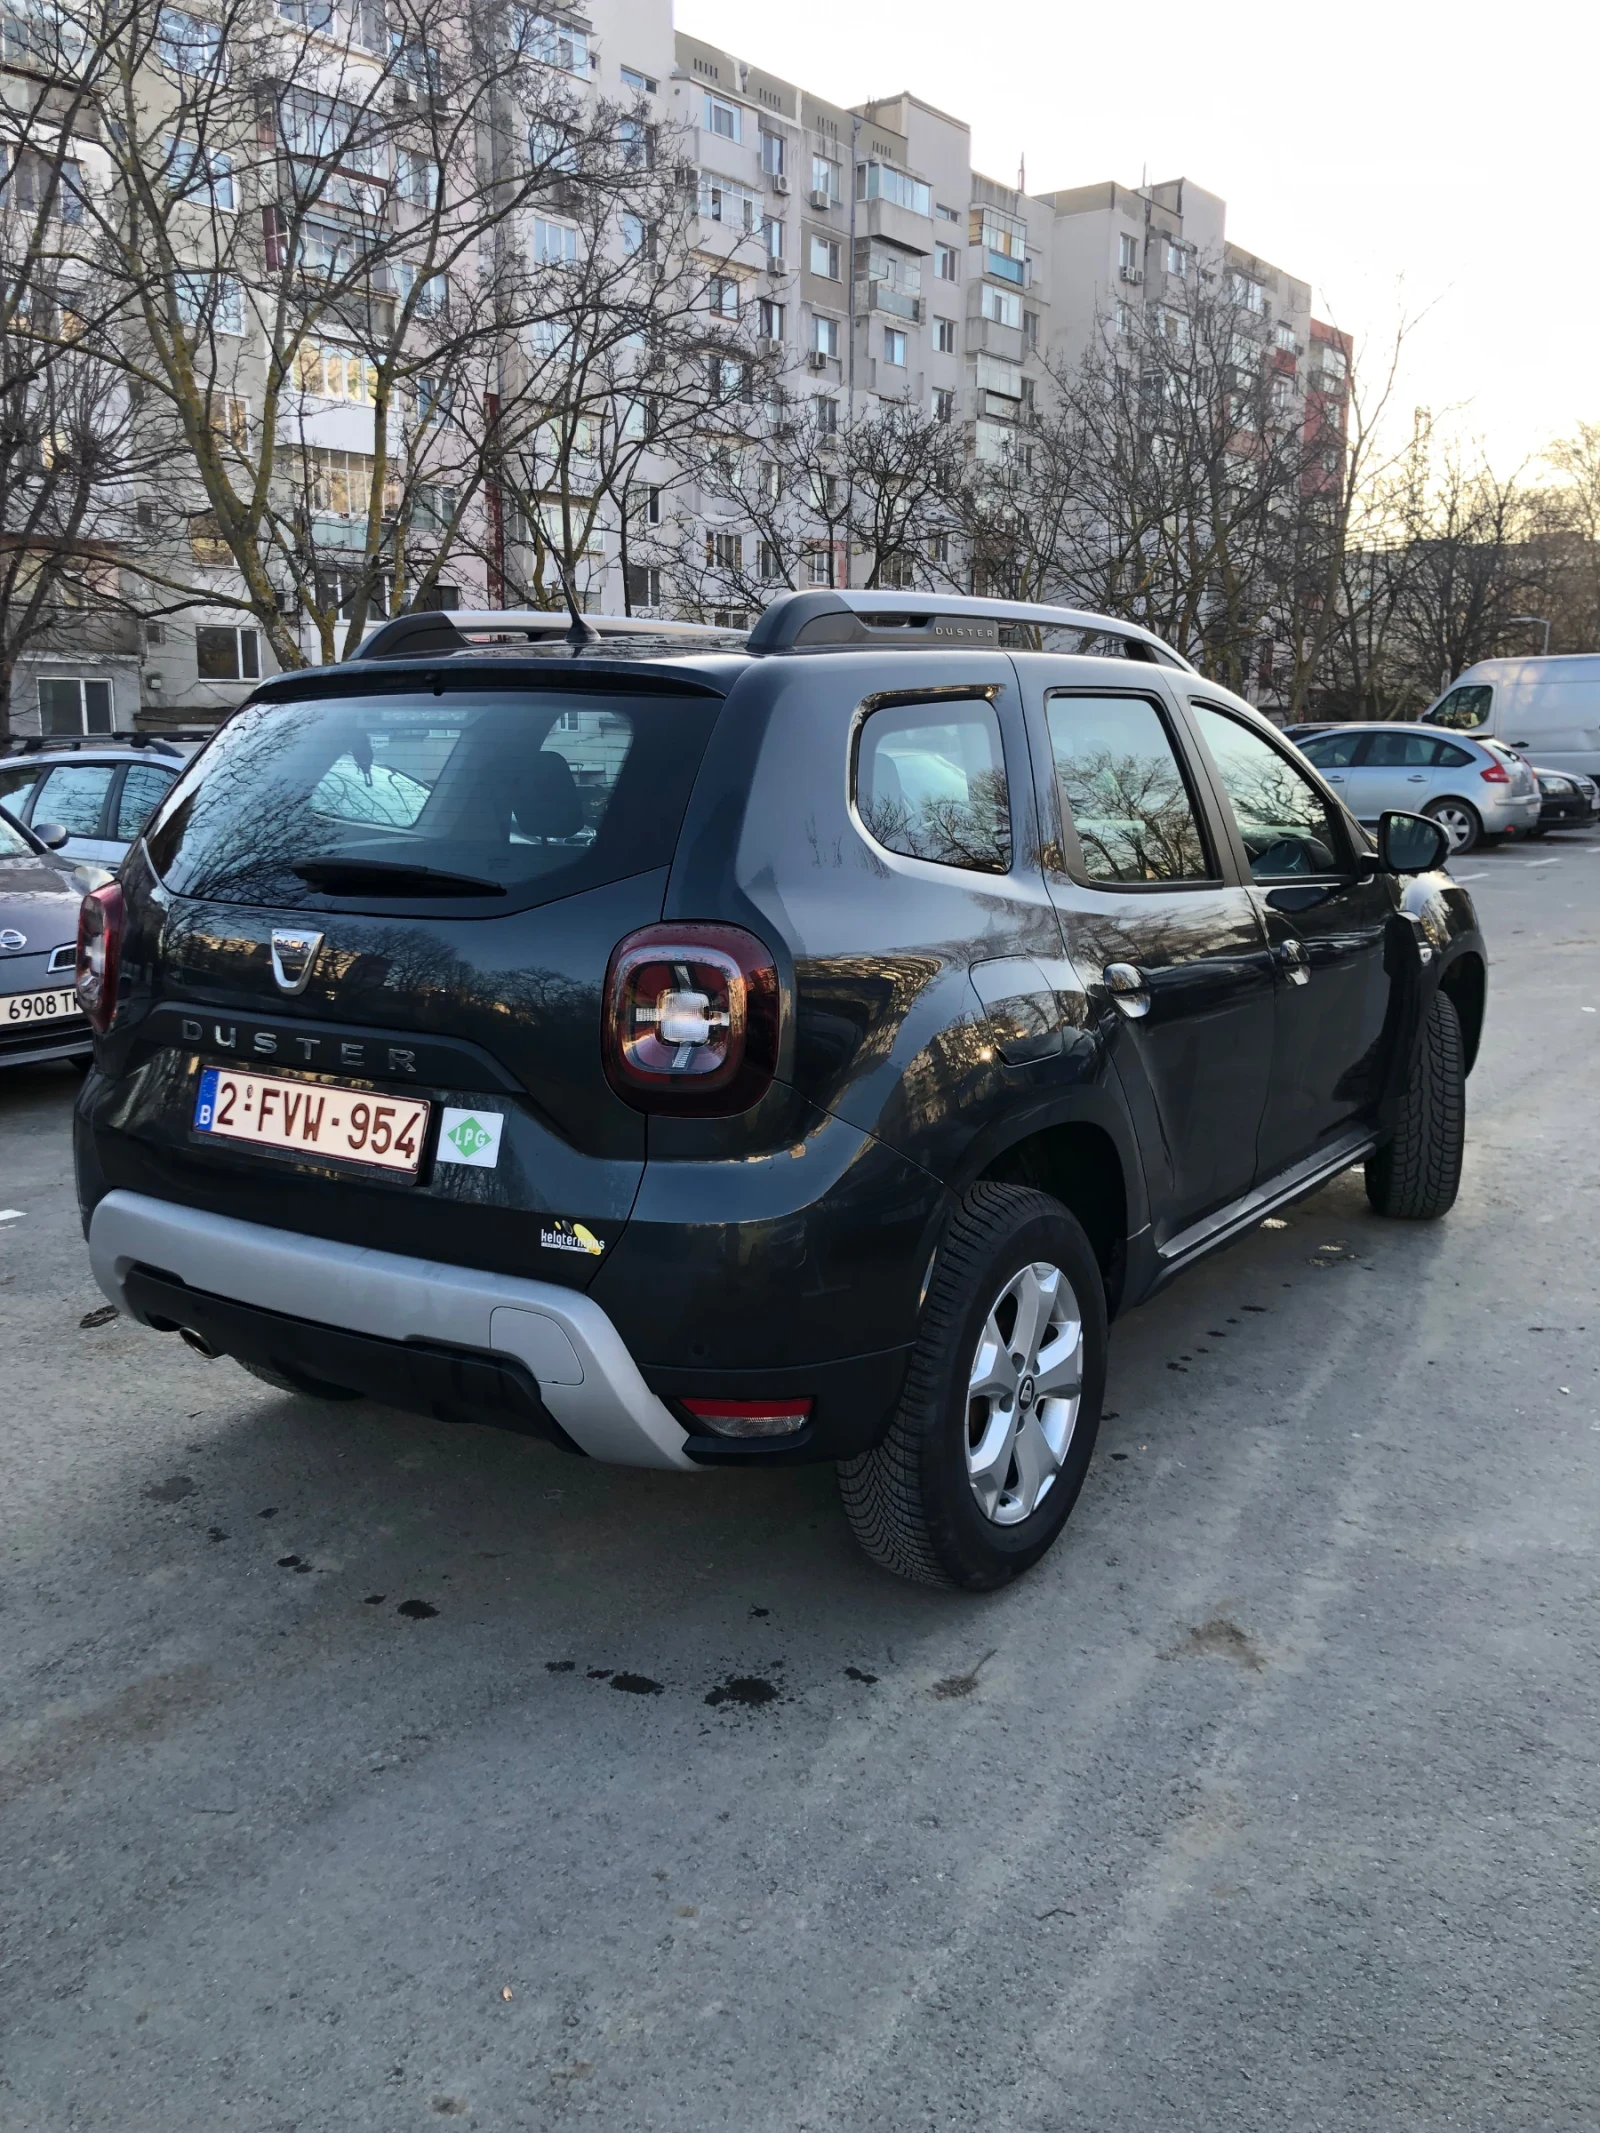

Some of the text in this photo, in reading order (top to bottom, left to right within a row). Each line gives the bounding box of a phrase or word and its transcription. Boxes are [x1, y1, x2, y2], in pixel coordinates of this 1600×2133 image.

[935, 627, 994, 637] DUSTER
[9, 994, 57, 1020] 6908
[182, 1019, 417, 1073] DUSTER
[199, 1104, 211, 1125] B
[454, 1126, 486, 1148] LPG
